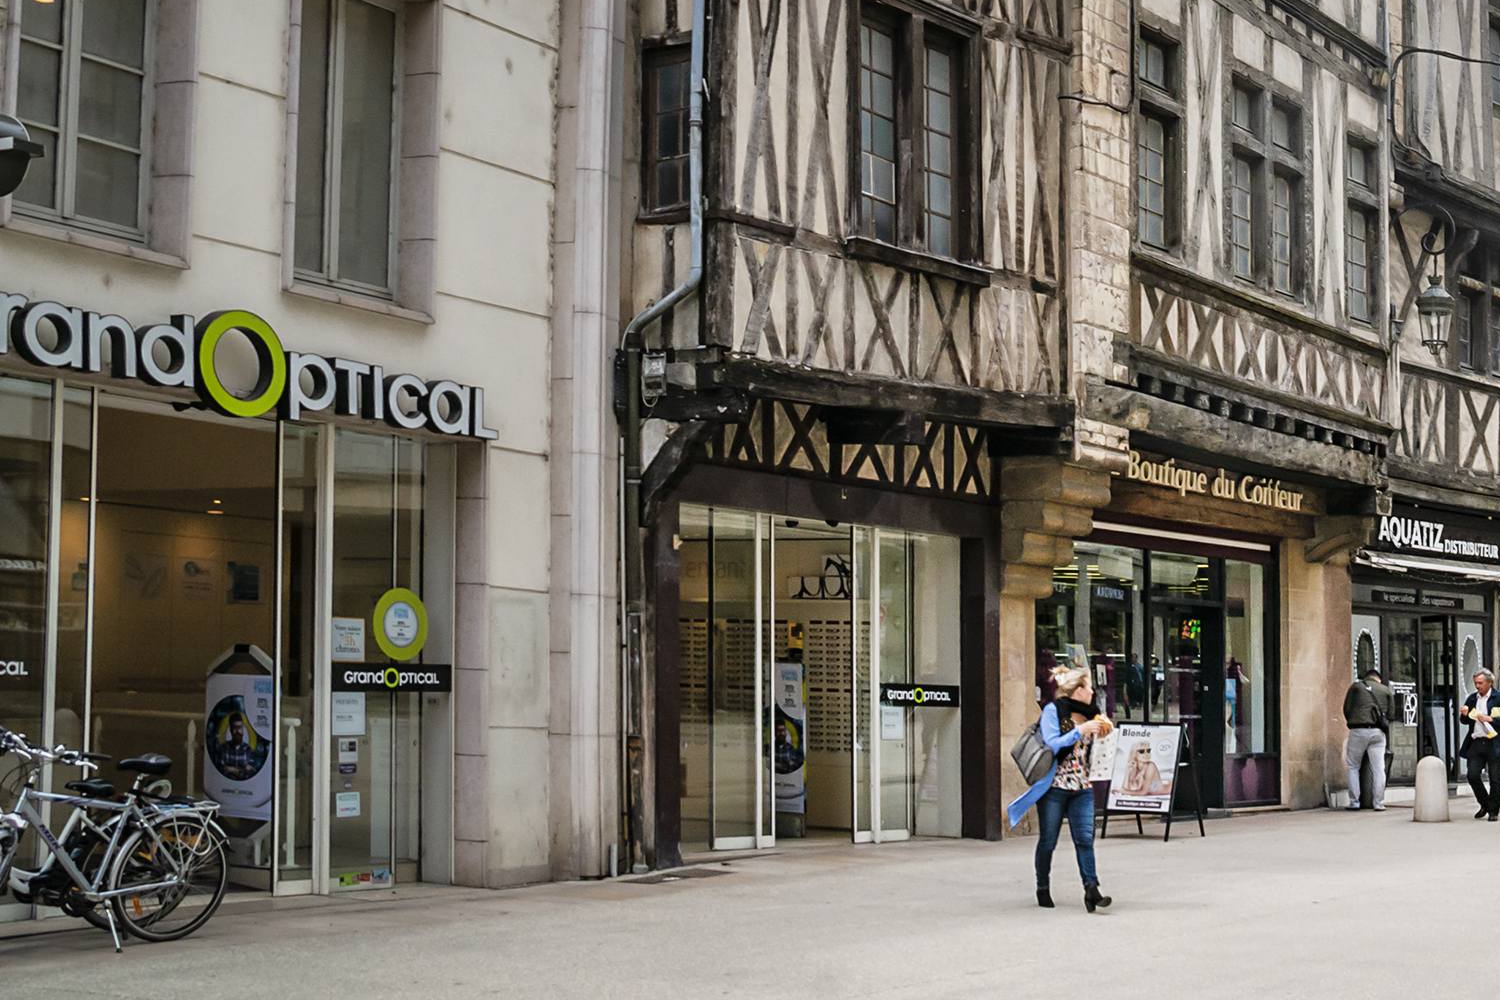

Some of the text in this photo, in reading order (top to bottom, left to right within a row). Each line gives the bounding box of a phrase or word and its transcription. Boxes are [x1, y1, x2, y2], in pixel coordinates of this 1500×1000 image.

[1127, 450, 1303, 511] Boutique du Coiffeur
[1444, 539, 1499, 559] DISTRIBUTEUR
[1122, 728, 1151, 737] Blonde
